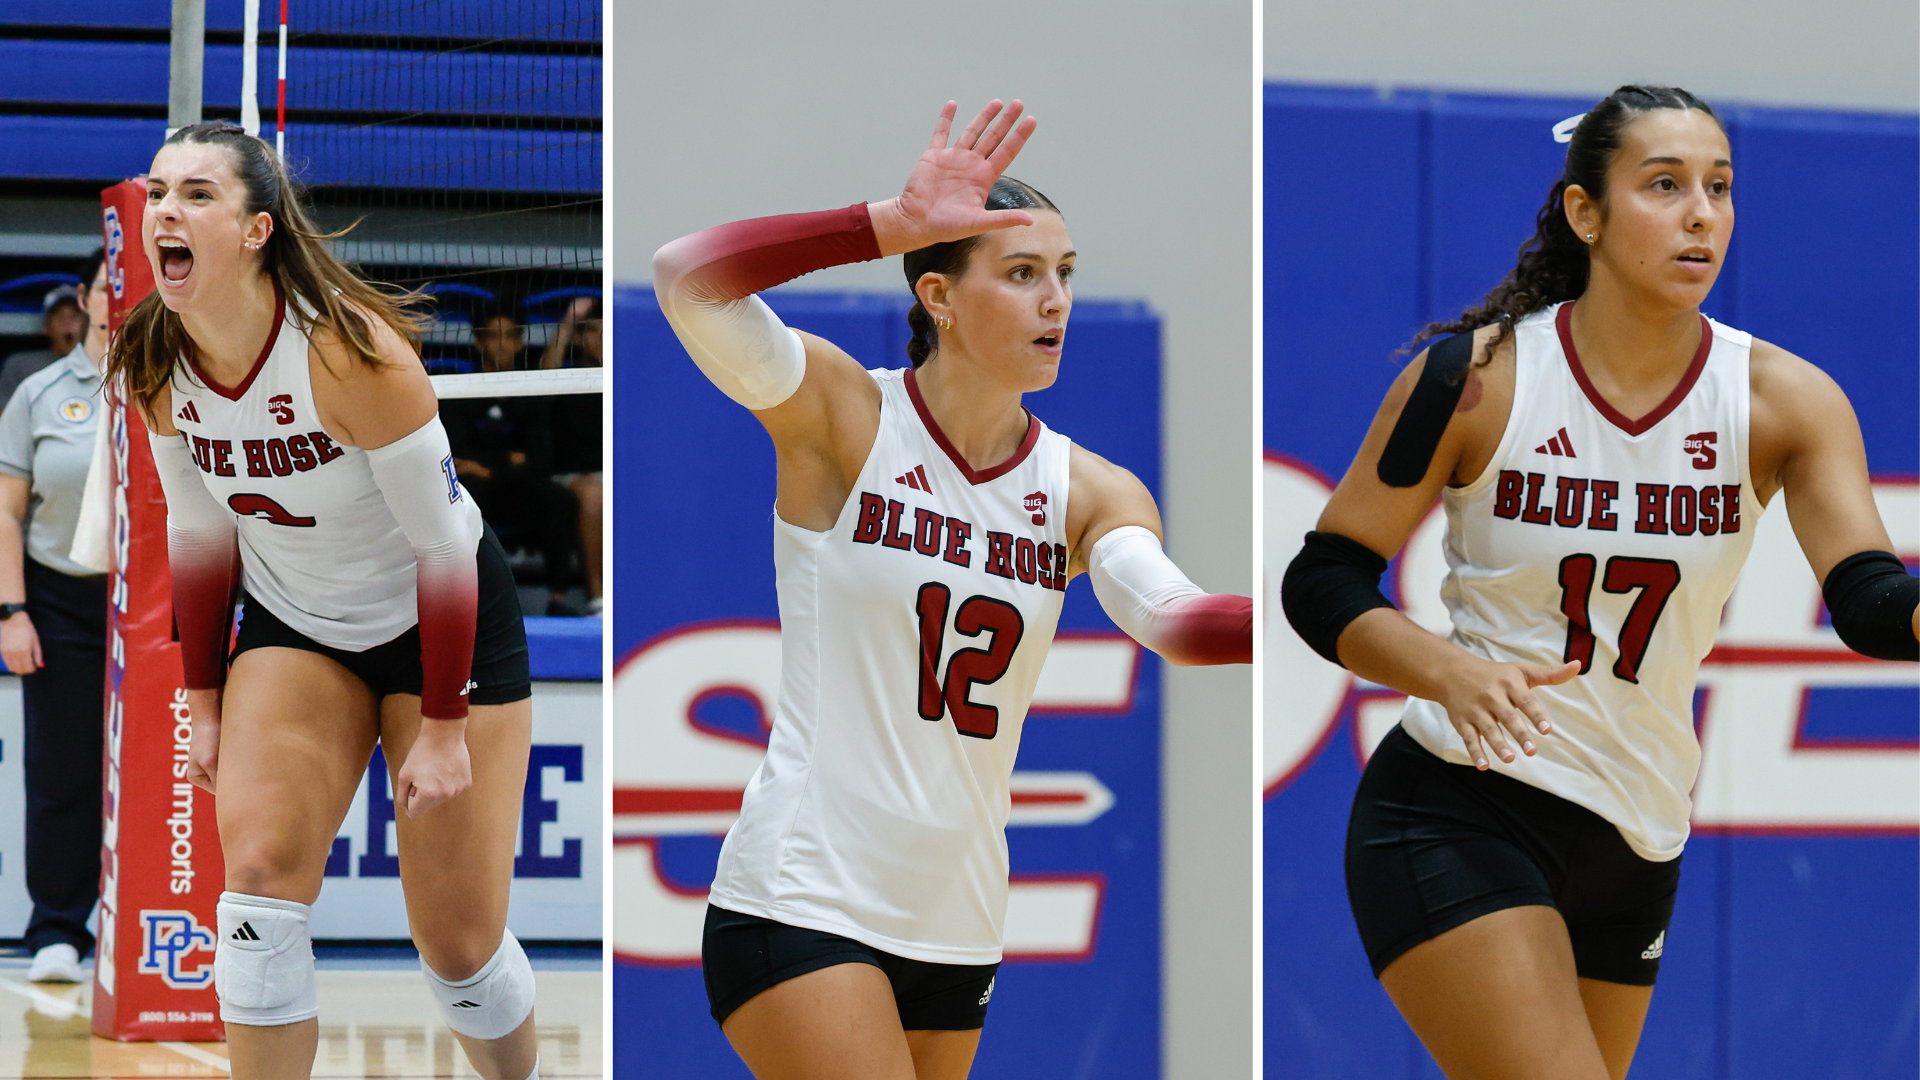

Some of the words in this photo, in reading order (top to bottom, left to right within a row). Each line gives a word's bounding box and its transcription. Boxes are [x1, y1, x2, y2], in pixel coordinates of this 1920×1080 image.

[242, 431, 345, 478] HOSE
[1494, 469, 1619, 531] BLUE
[1635, 482, 1742, 537] HOSE
[852, 491, 972, 569] BLUE
[985, 530, 1067, 592] HOSE
[916, 581, 1024, 740] 12
[1558, 553, 1682, 685] 17
[167, 782, 195, 895] imports
